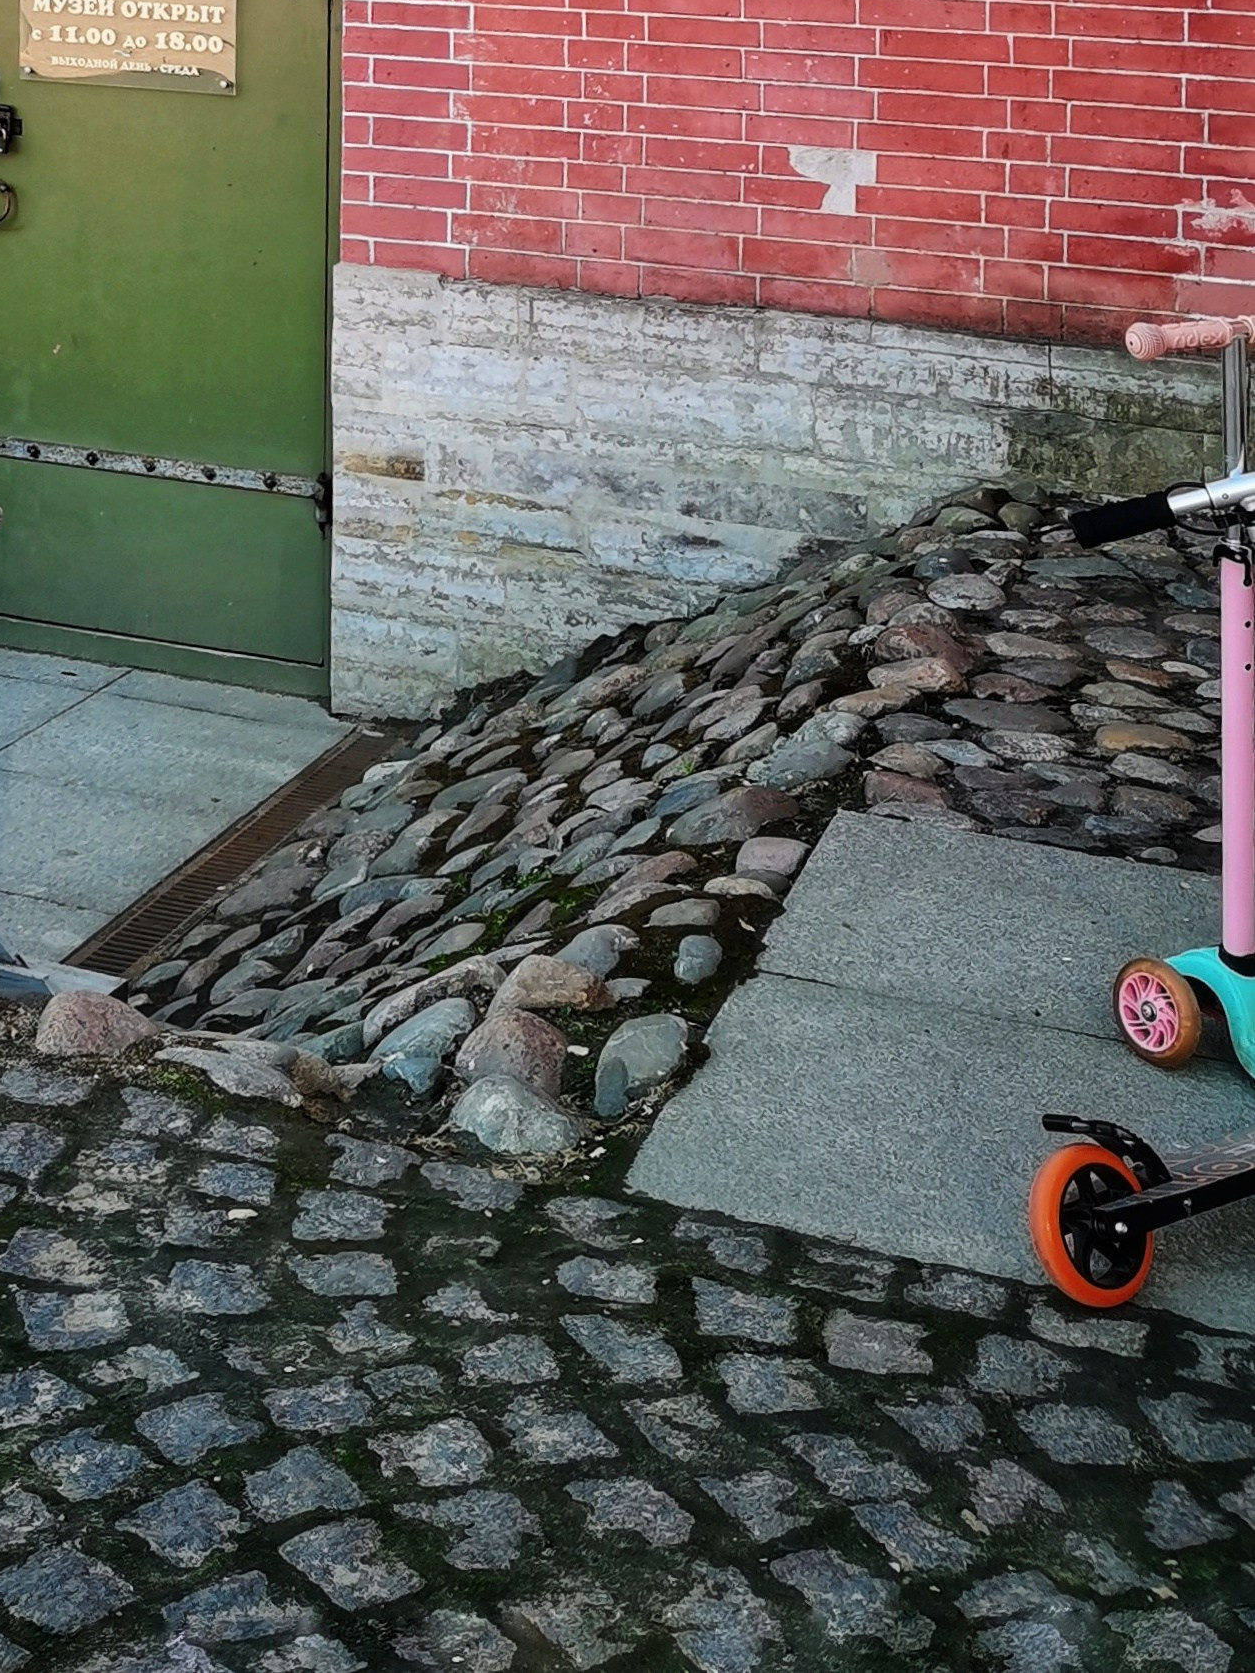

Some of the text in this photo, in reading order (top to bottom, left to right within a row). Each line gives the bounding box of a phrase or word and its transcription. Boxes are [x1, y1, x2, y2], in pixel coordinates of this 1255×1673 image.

[120, 0, 226, 24] ОТКРЫТ
[48, 25, 117, 46] 11.00
[154, 32, 224, 54] 18.00
[51, 56, 119, 70] ВЫХОДНОЙ
[119, 61, 151, 72] ДЕНЬ
[159, 64, 200, 76] СРЕДА
